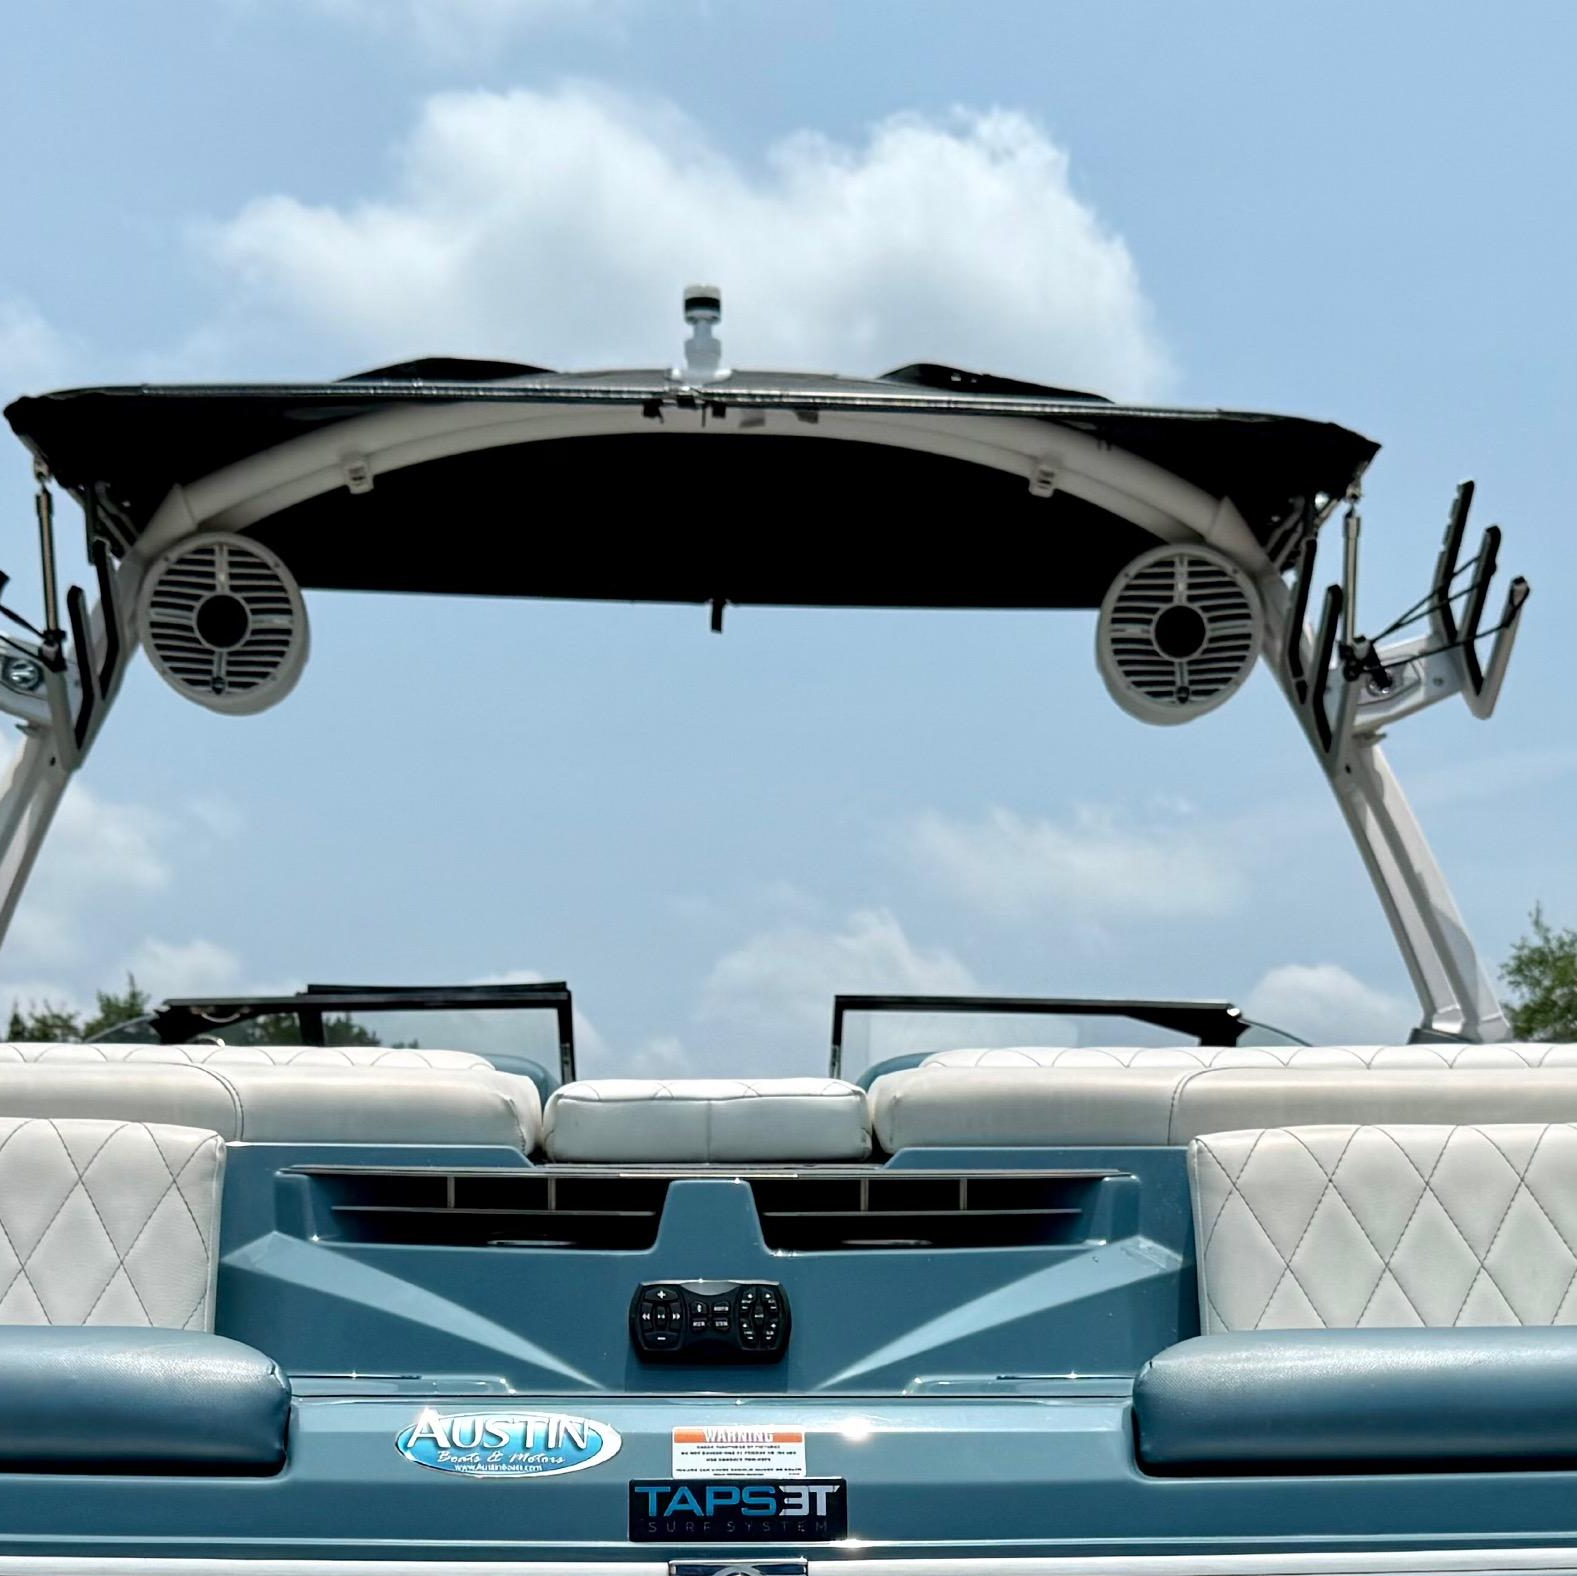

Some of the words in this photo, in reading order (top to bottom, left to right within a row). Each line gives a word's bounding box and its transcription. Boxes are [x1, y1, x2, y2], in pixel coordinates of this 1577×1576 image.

[407, 1406, 590, 1449] AUSTIN
[704, 1428, 774, 1443] WARNING
[437, 1450, 480, 1463] Boats
[509, 1451, 565, 1464] Motors
[648, 1521, 712, 1534] SURF
[727, 1521, 828, 1534] SYSTEM
